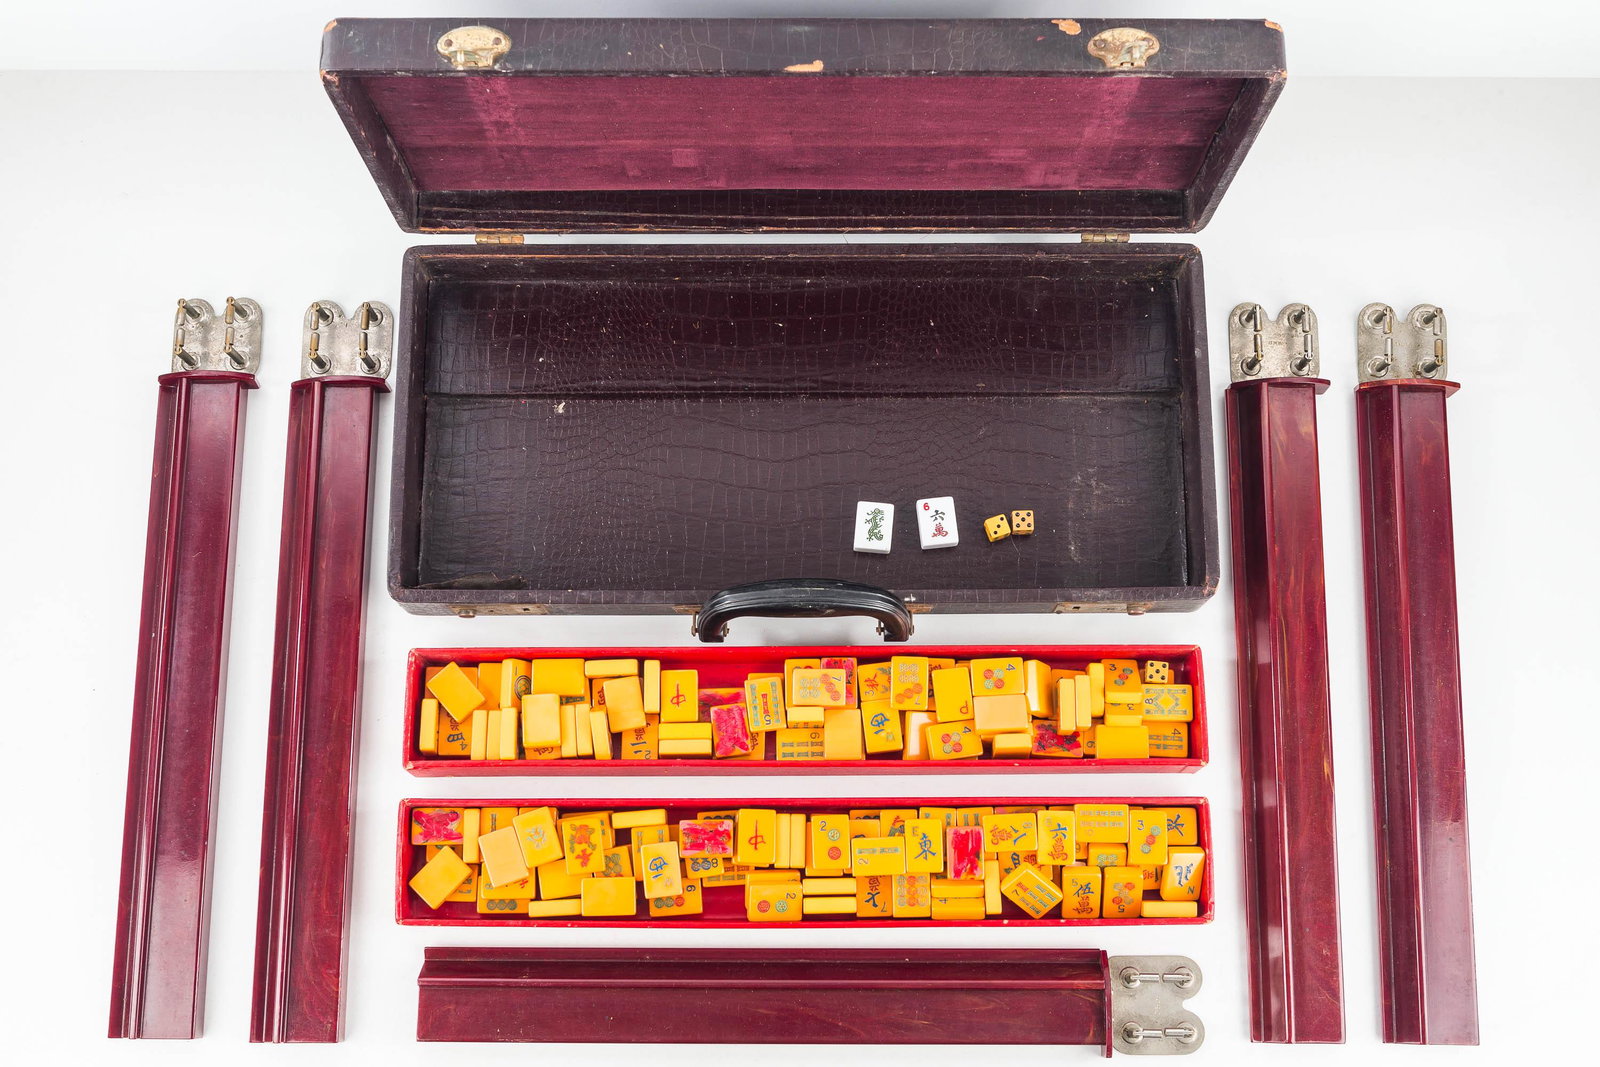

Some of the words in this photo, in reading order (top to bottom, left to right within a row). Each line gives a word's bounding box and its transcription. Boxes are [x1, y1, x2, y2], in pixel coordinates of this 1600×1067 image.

[923, 503, 930, 511] 6
[930, 510, 949, 537] 六萬
[670, 683, 686, 708] 中
[764, 714, 772, 725] 5
[460, 741, 468, 751] 4
[644, 750, 651, 760] 2
[820, 820, 827, 832] 2
[1137, 820, 1144, 830] 3
[748, 819, 766, 850] 中
[912, 826, 920, 837] E
[914, 832, 936, 860] 東
[1048, 822, 1068, 861] 六萬
[711, 858, 718, 868] 8
[1072, 878, 1078, 887] 5
[1188, 886, 1195, 894] N
[880, 902, 888, 912] 7
[1118, 904, 1126, 912] 5
